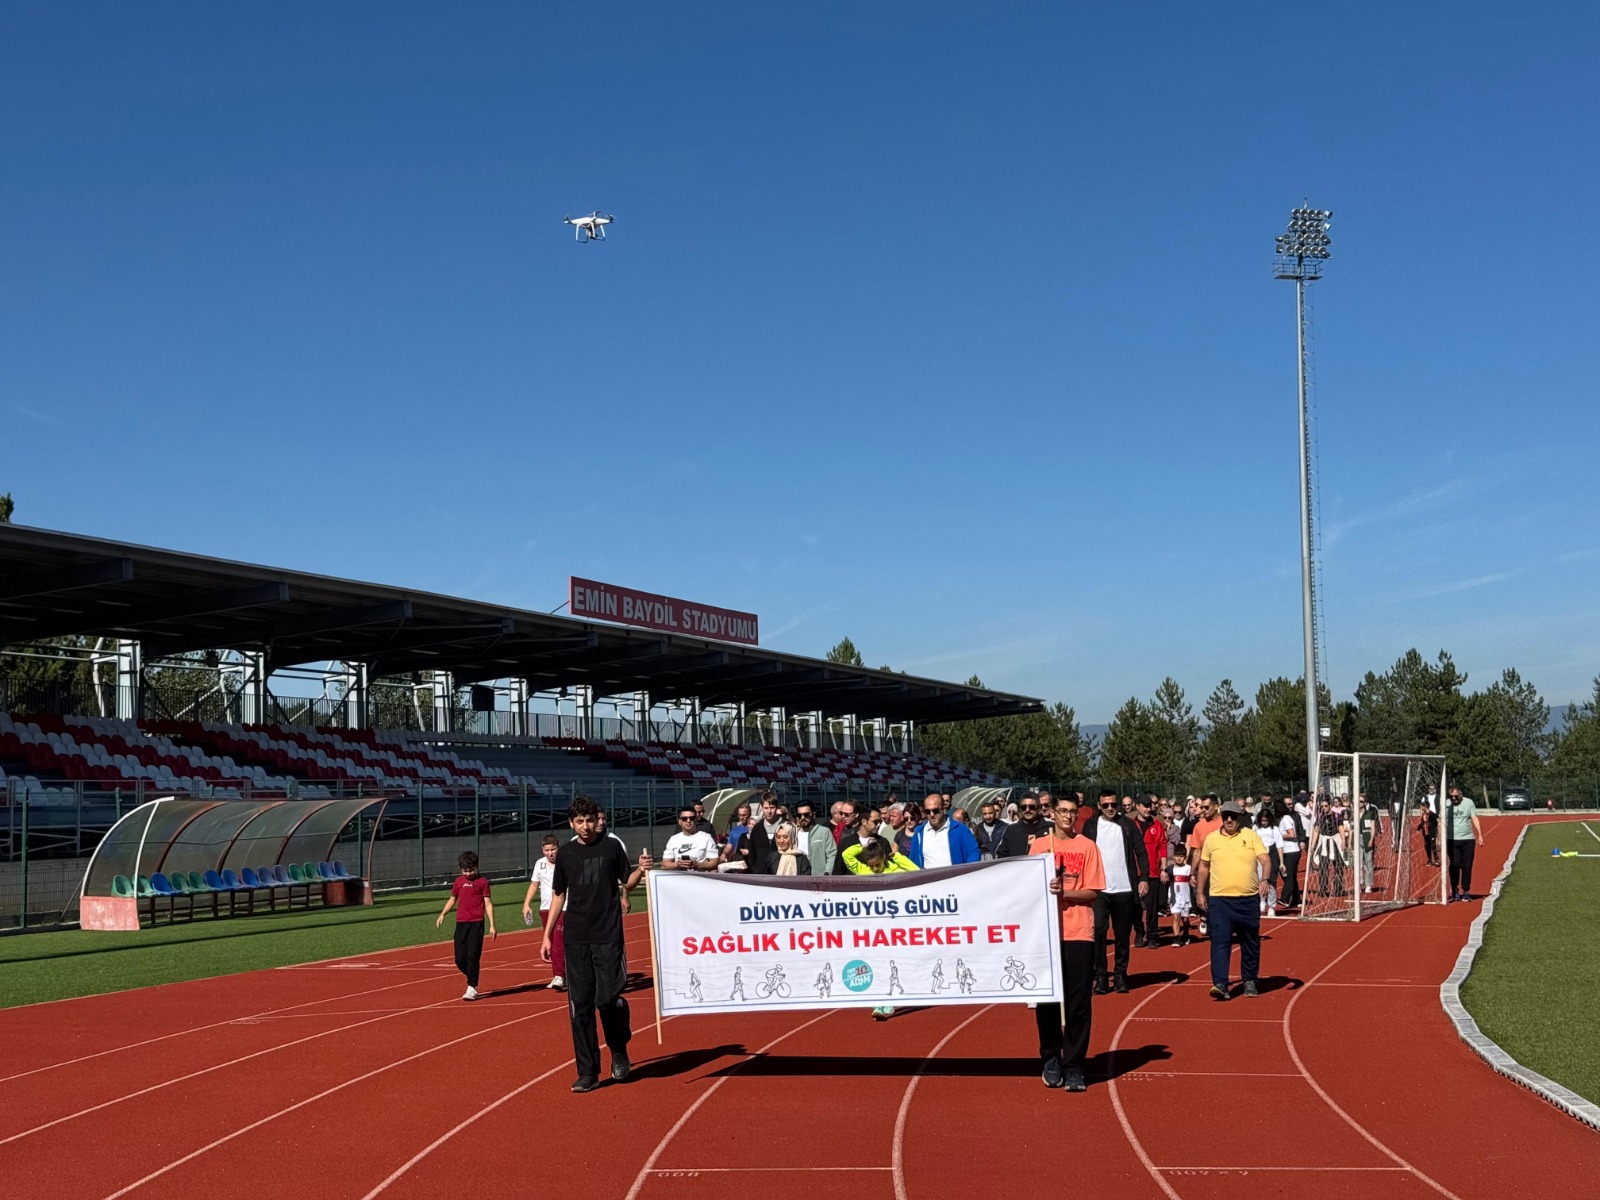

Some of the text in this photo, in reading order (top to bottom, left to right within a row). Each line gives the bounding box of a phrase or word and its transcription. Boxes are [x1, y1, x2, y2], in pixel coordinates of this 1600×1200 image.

[573, 585, 757, 640] EMİN BAYDİL STADYUMU
[739, 896, 958, 921] DÜNYA YÜRÜYÜŞ GÜNÜ
[682, 924, 1020, 955] SAĞLIK İÇİN HAREKET ET
